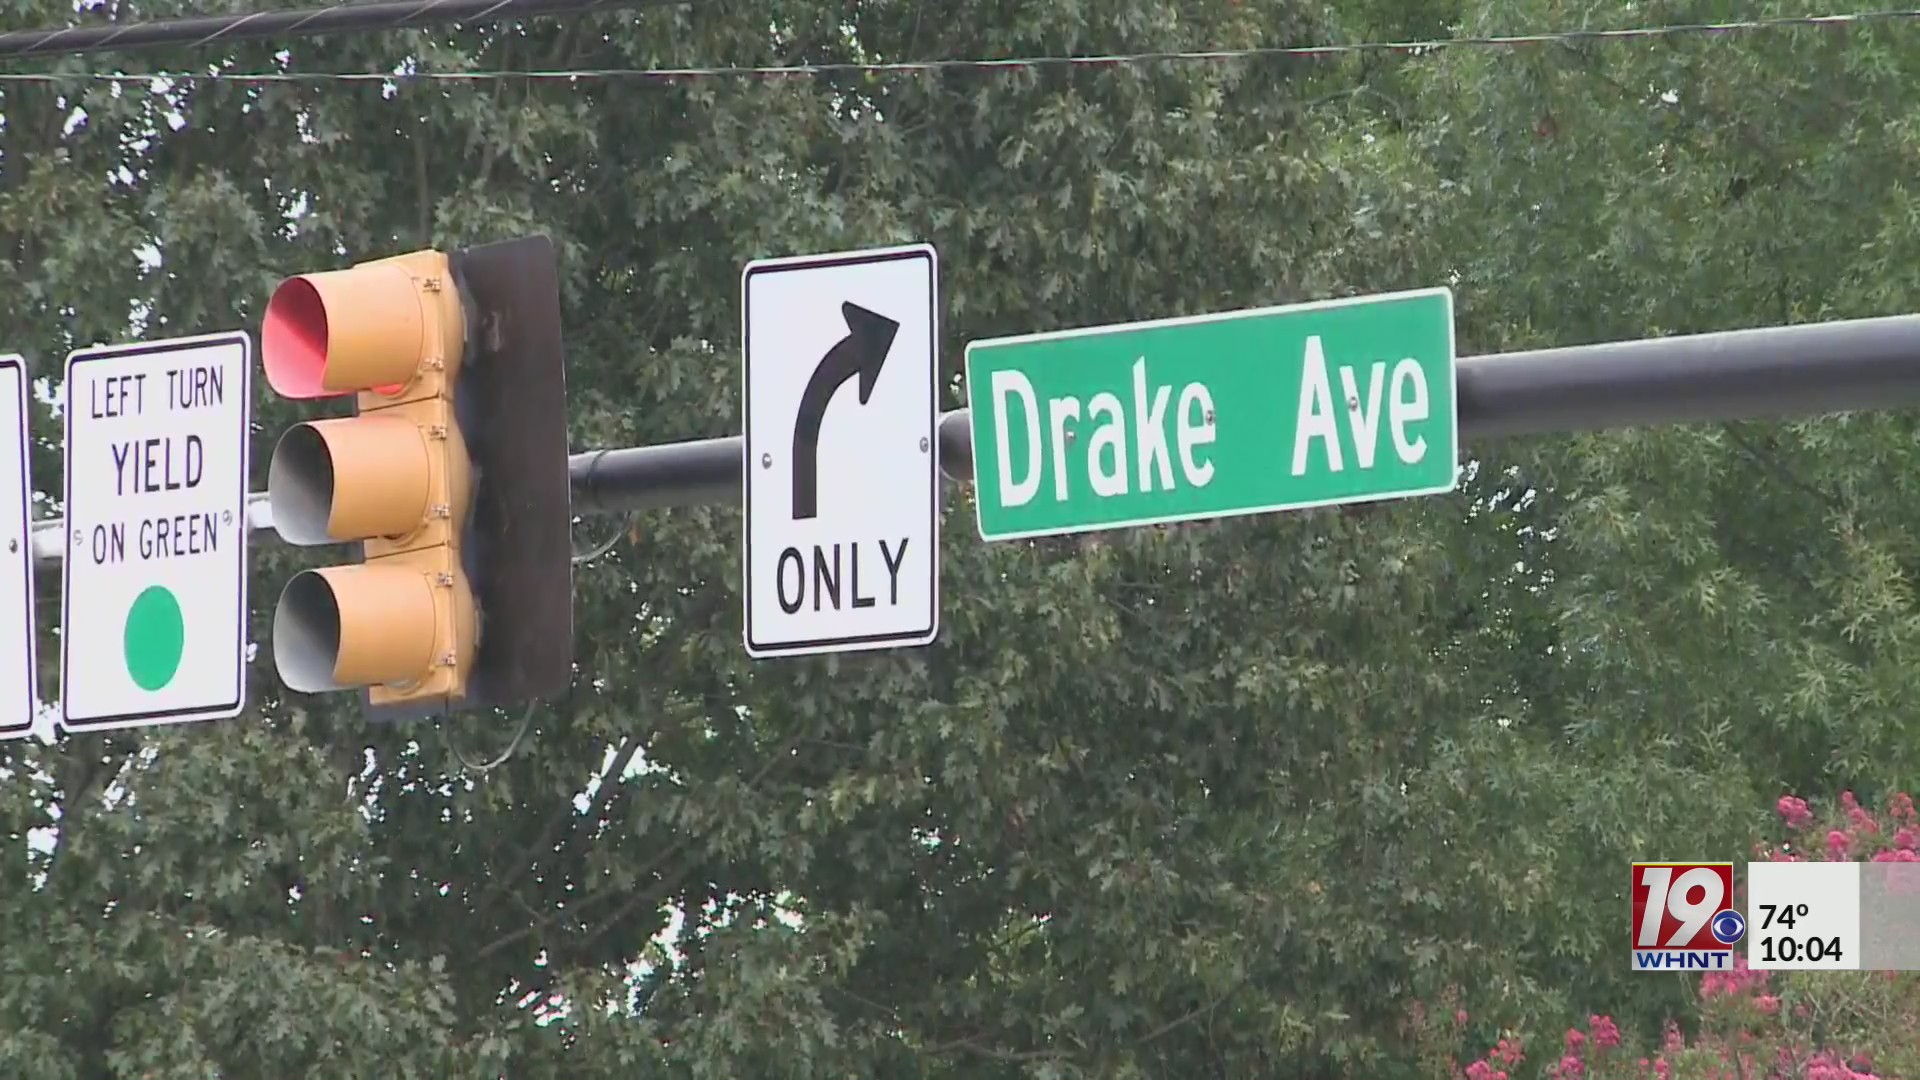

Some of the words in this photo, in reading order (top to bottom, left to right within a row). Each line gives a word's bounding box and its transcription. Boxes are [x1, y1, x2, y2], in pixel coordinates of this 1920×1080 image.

[91, 373, 147, 419] LEFT
[166, 365, 224, 410] TURN
[991, 356, 1216, 507] Drake
[1291, 335, 1430, 477] Ave
[111, 434, 203, 496] YIELD
[92, 521, 125, 565] ON
[139, 512, 218, 560] GREEN
[777, 536, 909, 614] ONLY
